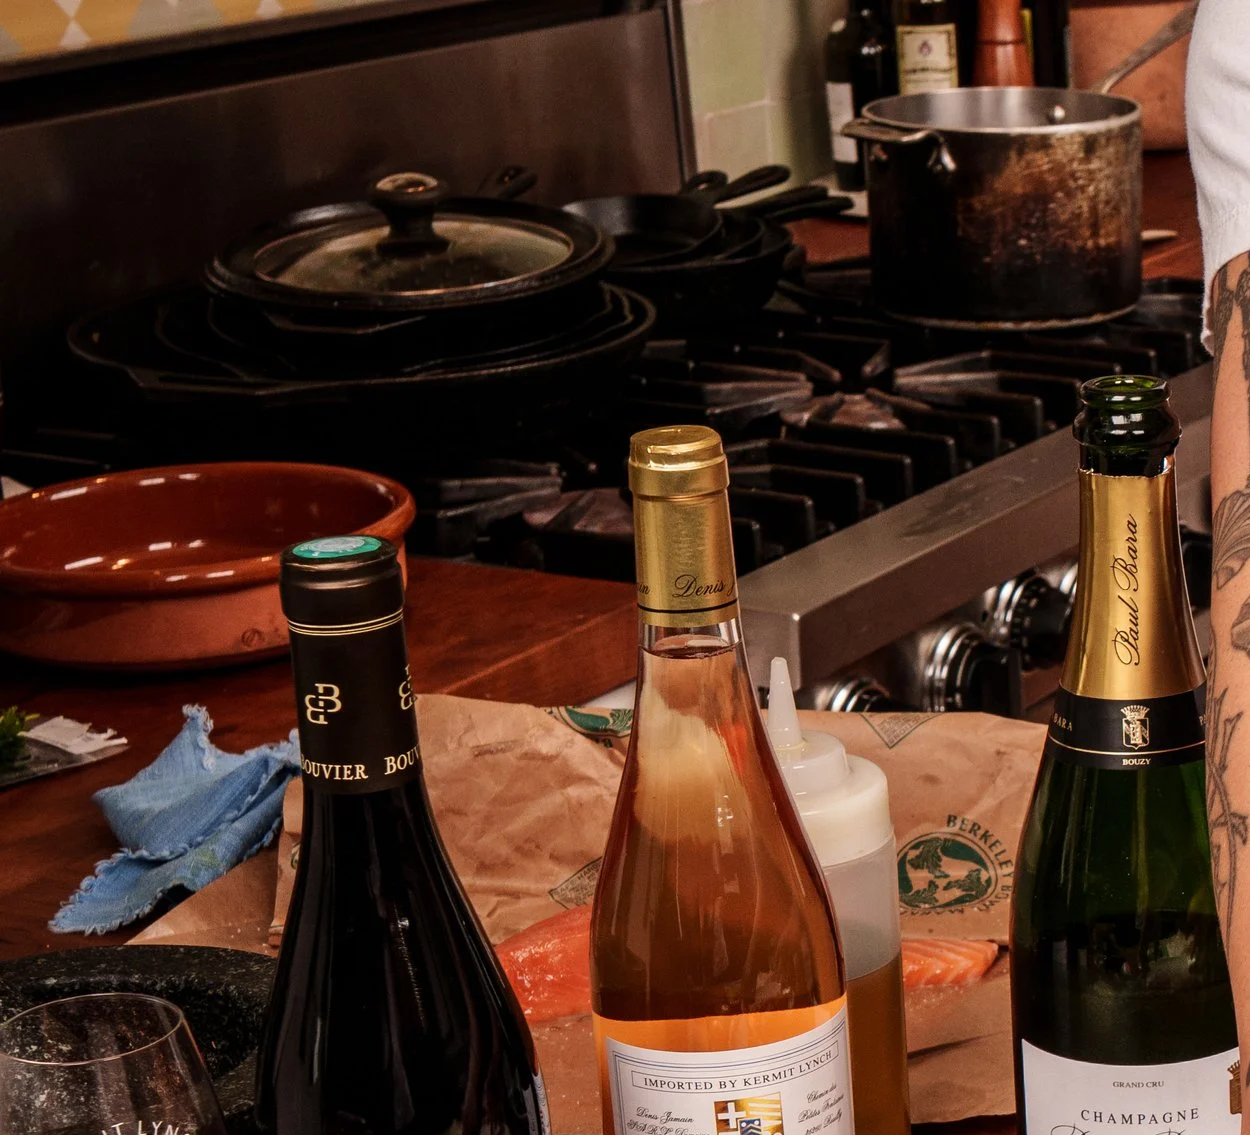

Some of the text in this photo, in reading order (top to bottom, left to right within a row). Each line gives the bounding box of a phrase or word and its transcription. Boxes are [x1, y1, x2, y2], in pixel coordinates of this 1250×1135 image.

[672, 574, 724, 598] Denis
[1110, 513, 1140, 666] Paul Bara
[300, 746, 421, 781] BOUVIER BOUV
[1122, 757, 1151, 766] BOUZY
[946, 814, 1014, 880] BERKELEY
[643, 1050, 833, 1090] IMPORTED BY KERMIT LYNCH
[1112, 1080, 1165, 1088] GRAND CRU
[636, 1106, 659, 1120] Denis
[1080, 1108, 1200, 1125] CHAMPAGNE
